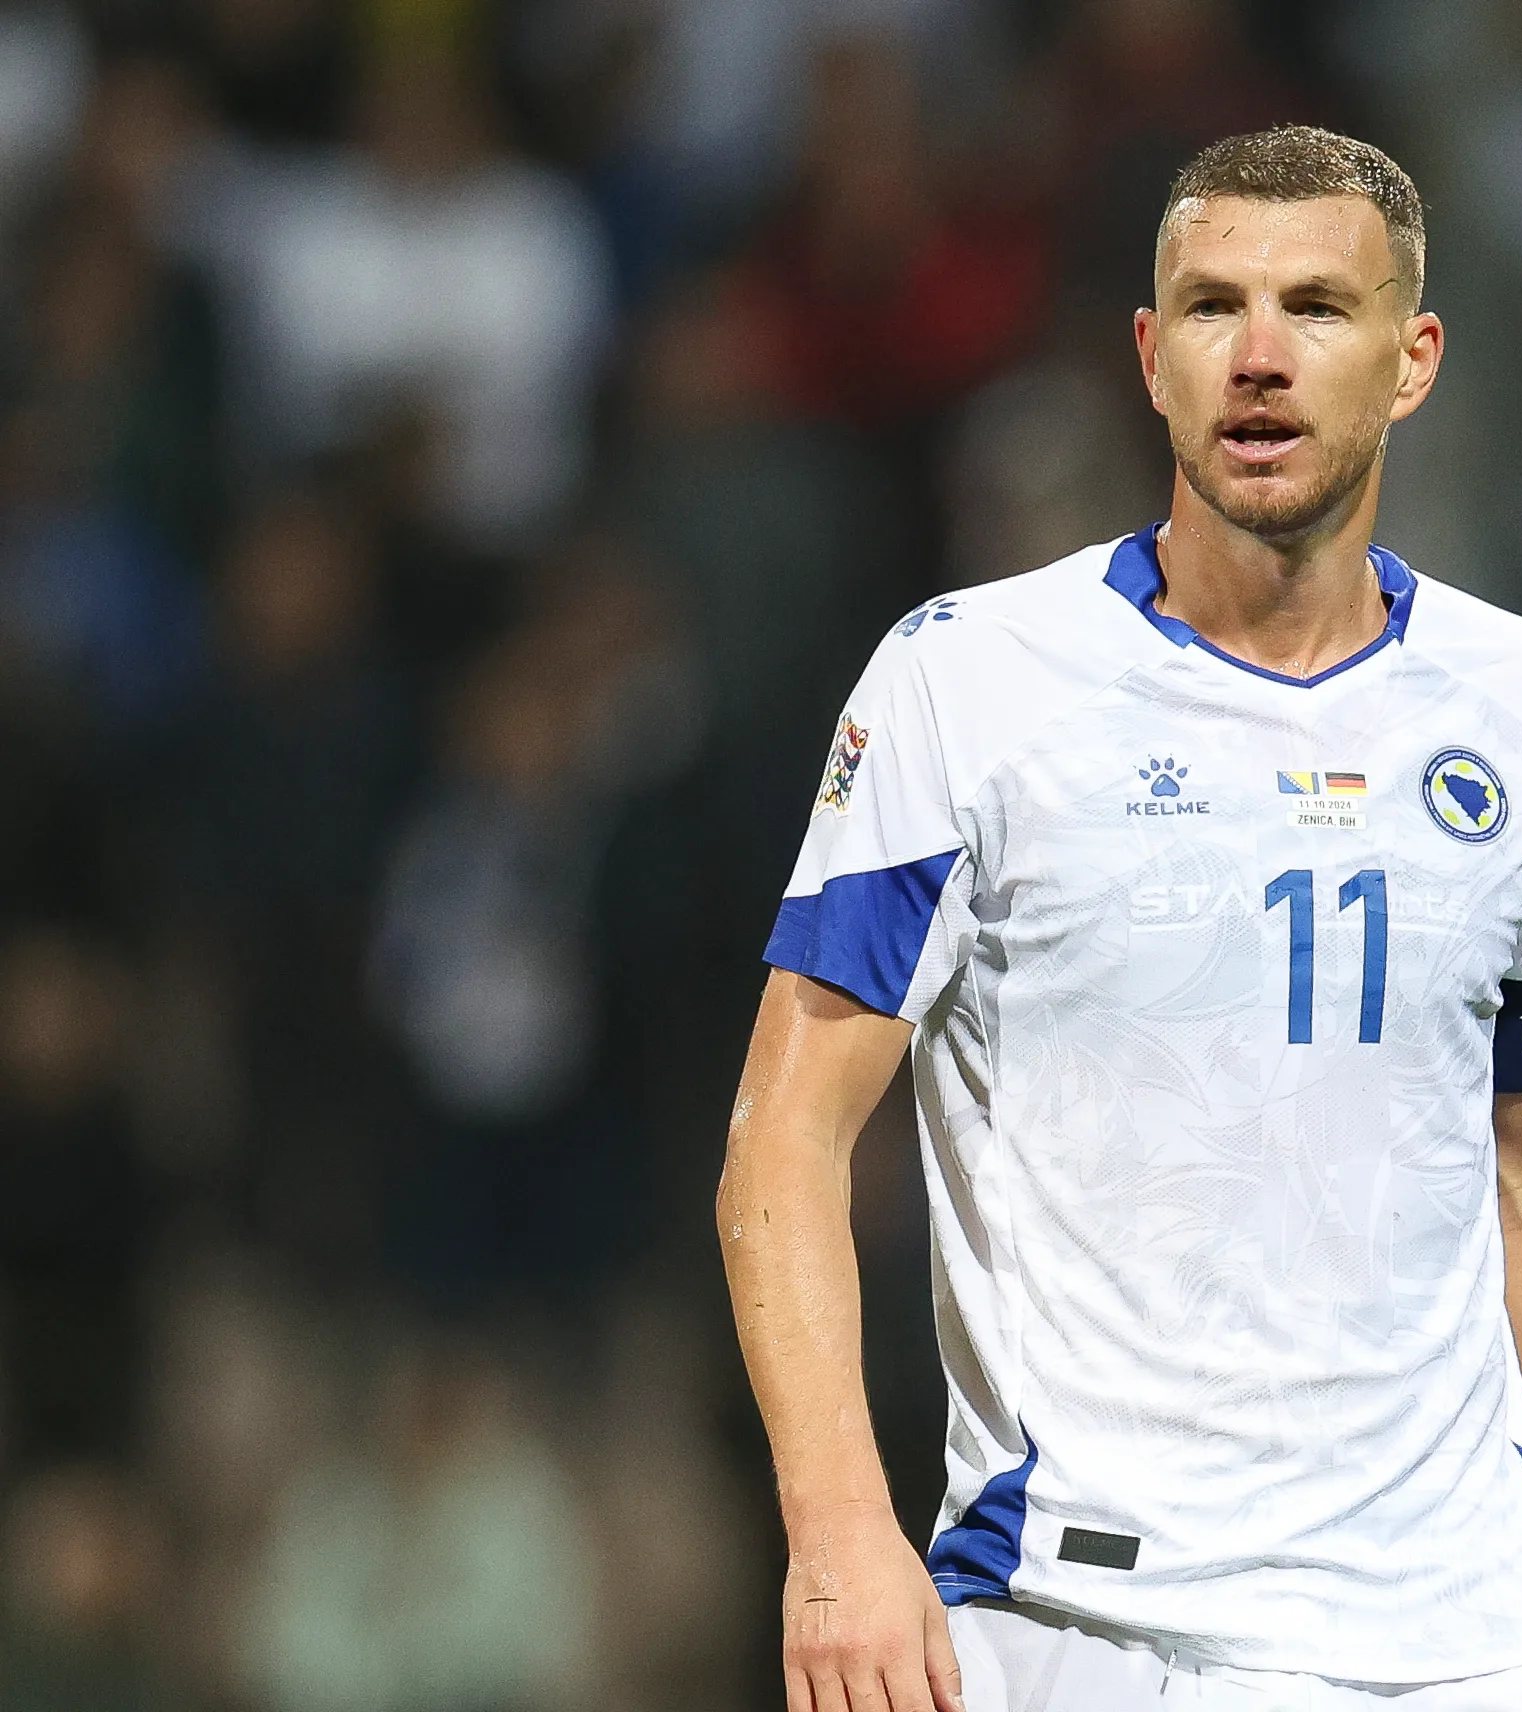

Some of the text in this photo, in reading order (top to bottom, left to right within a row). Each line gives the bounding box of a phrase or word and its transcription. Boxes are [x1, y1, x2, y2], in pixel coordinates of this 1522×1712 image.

[1126, 801, 1210, 816] KELME
[1299, 800, 1352, 809] 11102024
[1265, 869, 1388, 1044] 11
